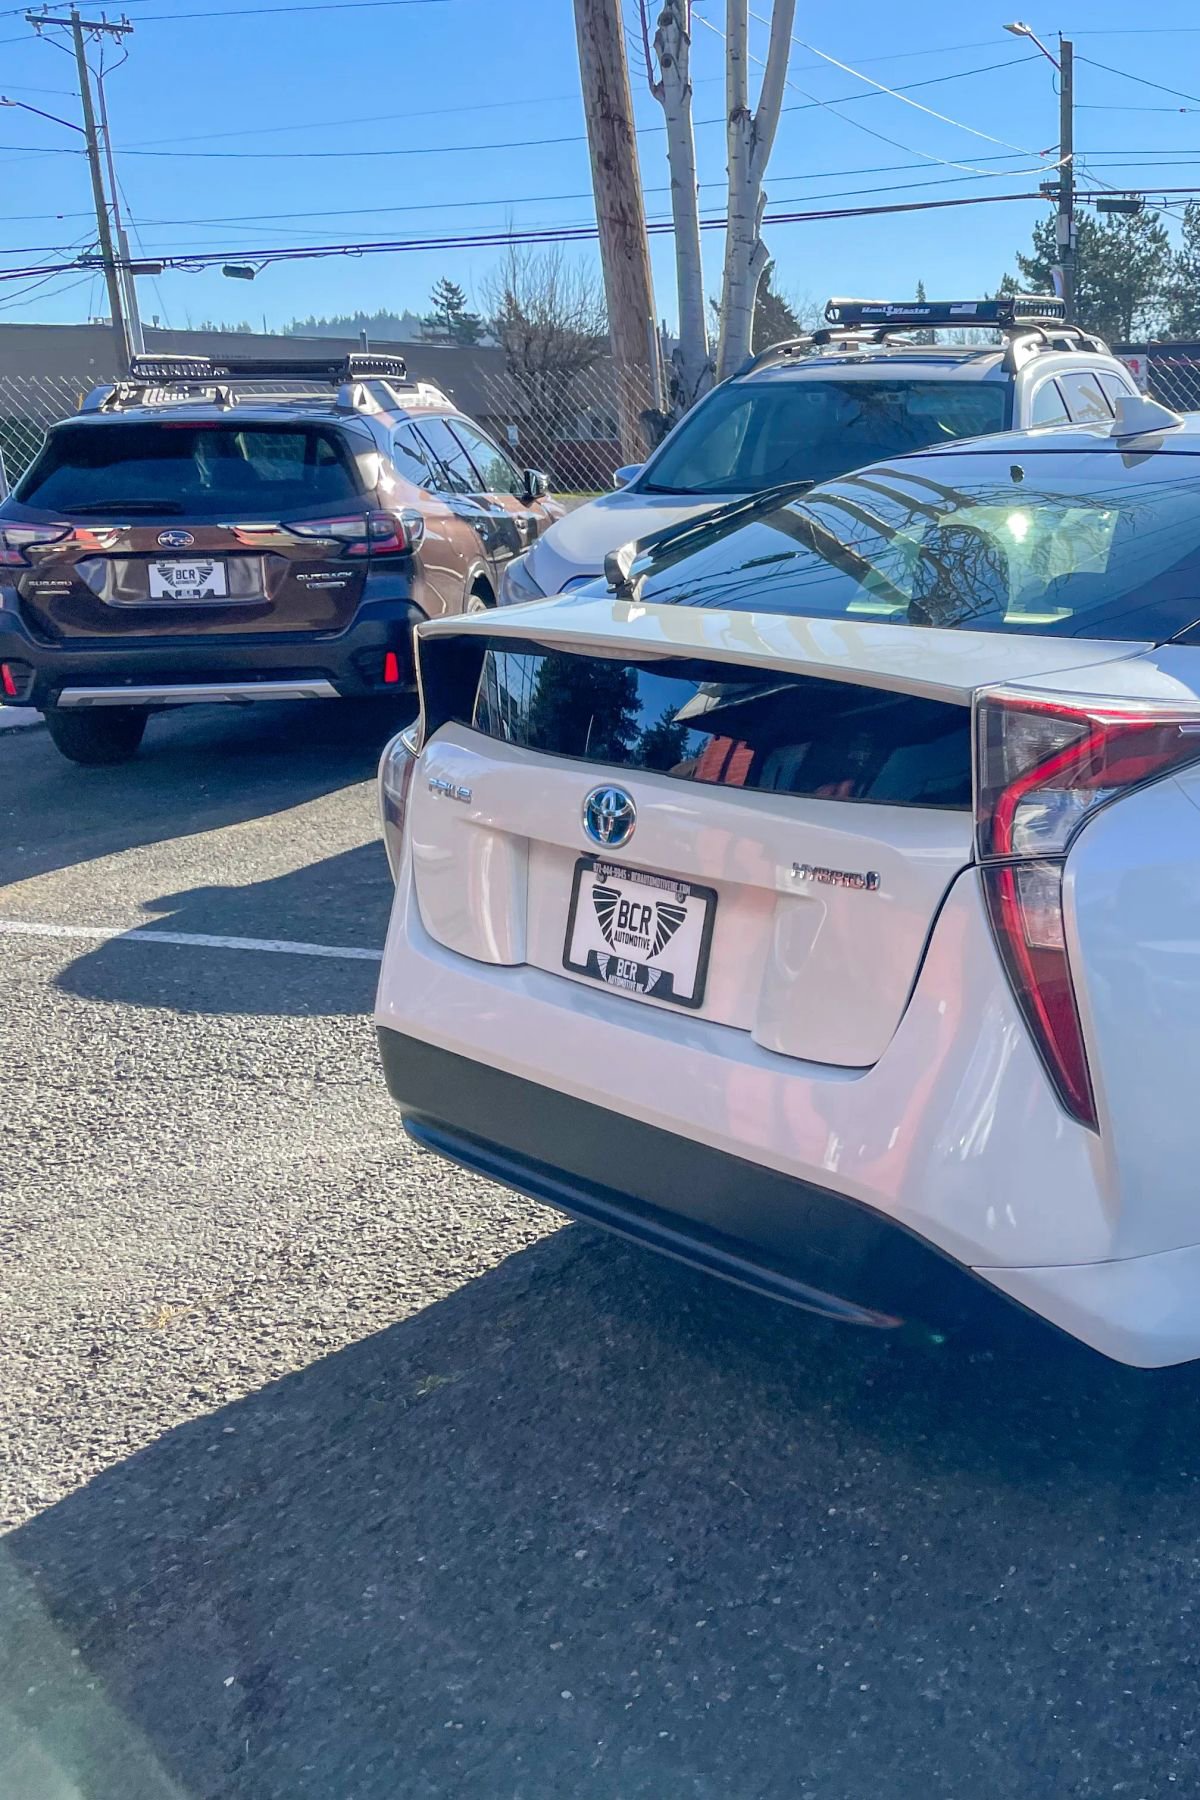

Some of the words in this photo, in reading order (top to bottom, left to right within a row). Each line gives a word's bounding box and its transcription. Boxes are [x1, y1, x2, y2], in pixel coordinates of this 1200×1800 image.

[175, 569, 196, 580] BCR
[617, 899, 653, 936] BCR
[614, 930, 651, 951] AUTOMOTIVE
[616, 958, 638, 981] BCR
